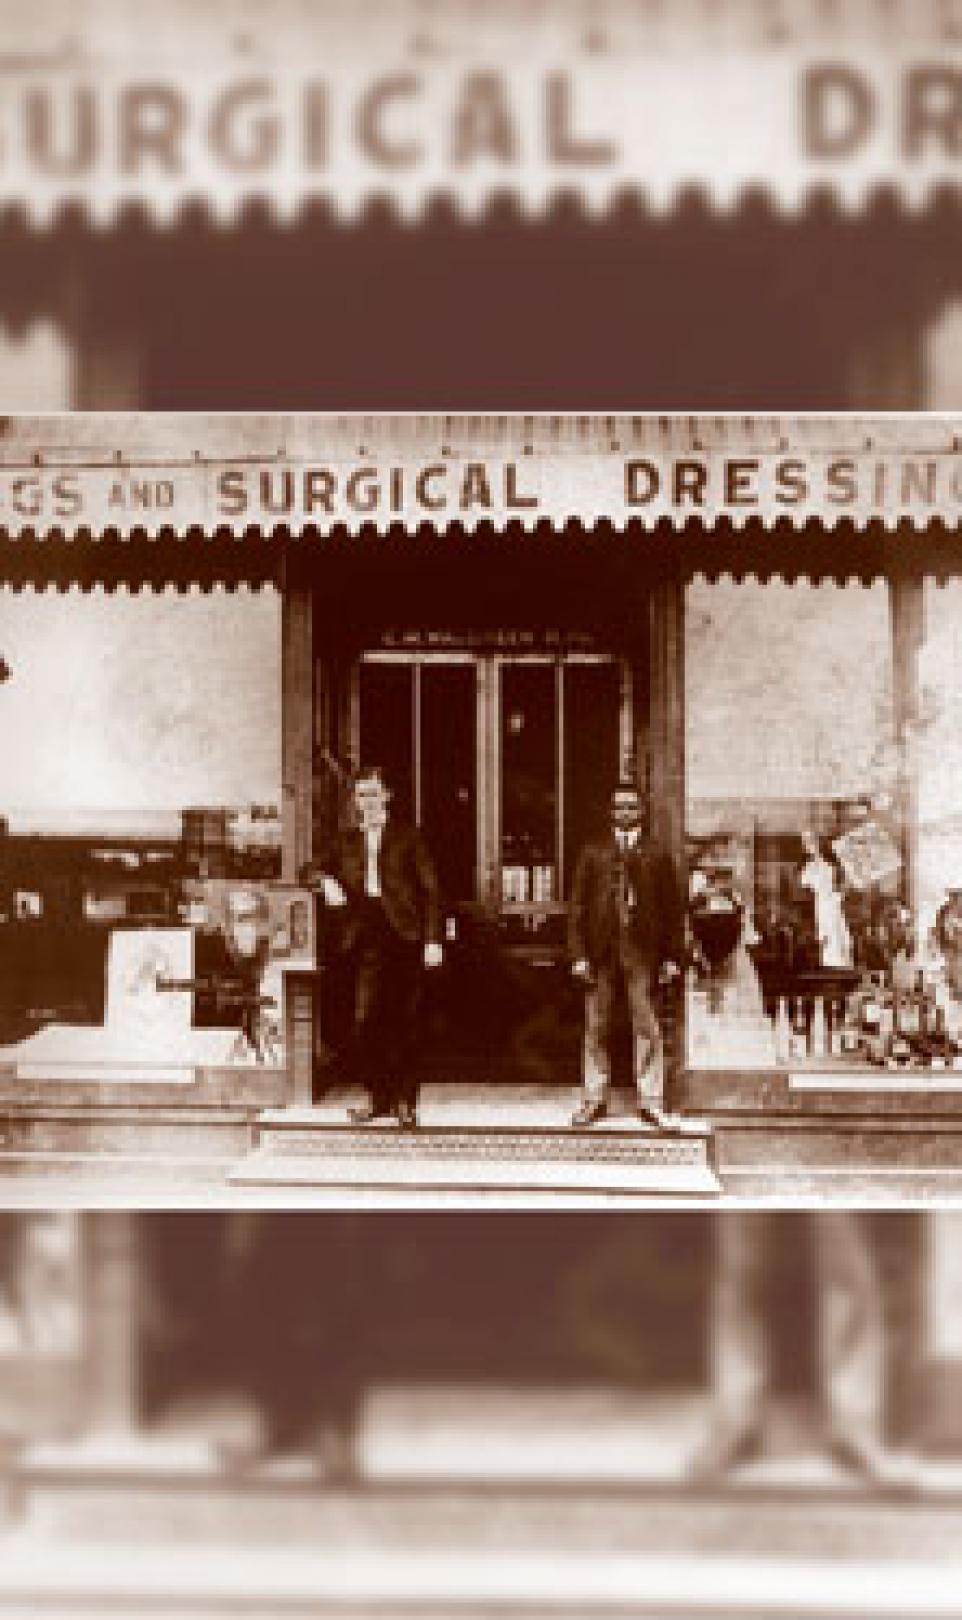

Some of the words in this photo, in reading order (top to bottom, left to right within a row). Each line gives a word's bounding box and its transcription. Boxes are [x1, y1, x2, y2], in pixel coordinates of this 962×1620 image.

[0, 66, 620, 180] URGICAL
[10, 475, 84, 517] GS
[107, 479, 175, 508] AND
[216, 462, 540, 516] SURGICAL
